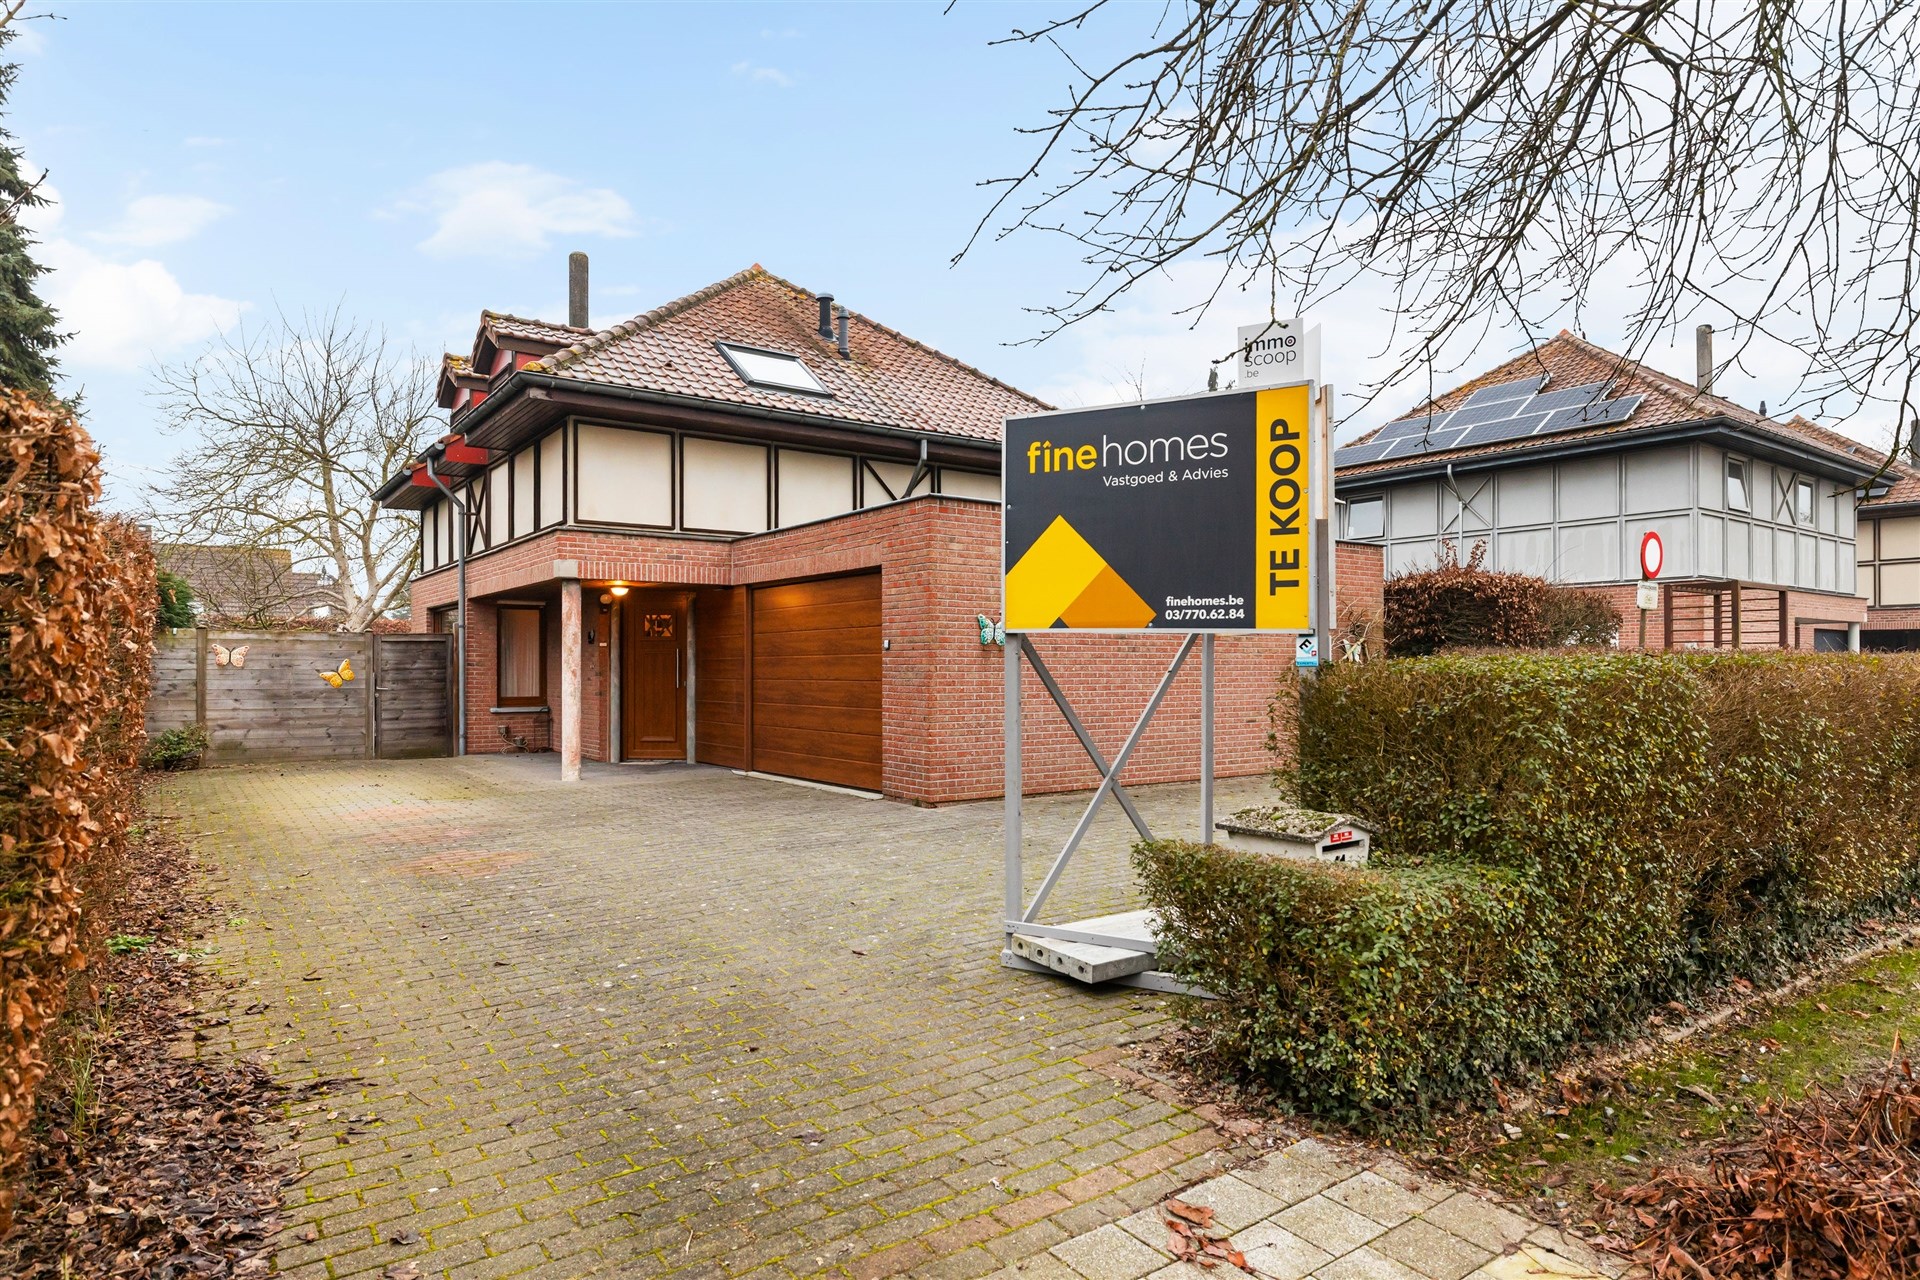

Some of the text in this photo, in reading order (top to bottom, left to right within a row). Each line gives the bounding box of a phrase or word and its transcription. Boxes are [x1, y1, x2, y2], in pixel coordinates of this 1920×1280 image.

[1244, 335, 1296, 353] immo
[1244, 350, 1297, 367] scoop
[1244, 369, 1259, 379] .be
[1102, 467, 1229, 487] Vastgoed & Advies
[1269, 418, 1301, 596] TE KOOP
[1165, 595, 1244, 607] finehomes.be
[1165, 608, 1245, 620] 03/770.62.84
